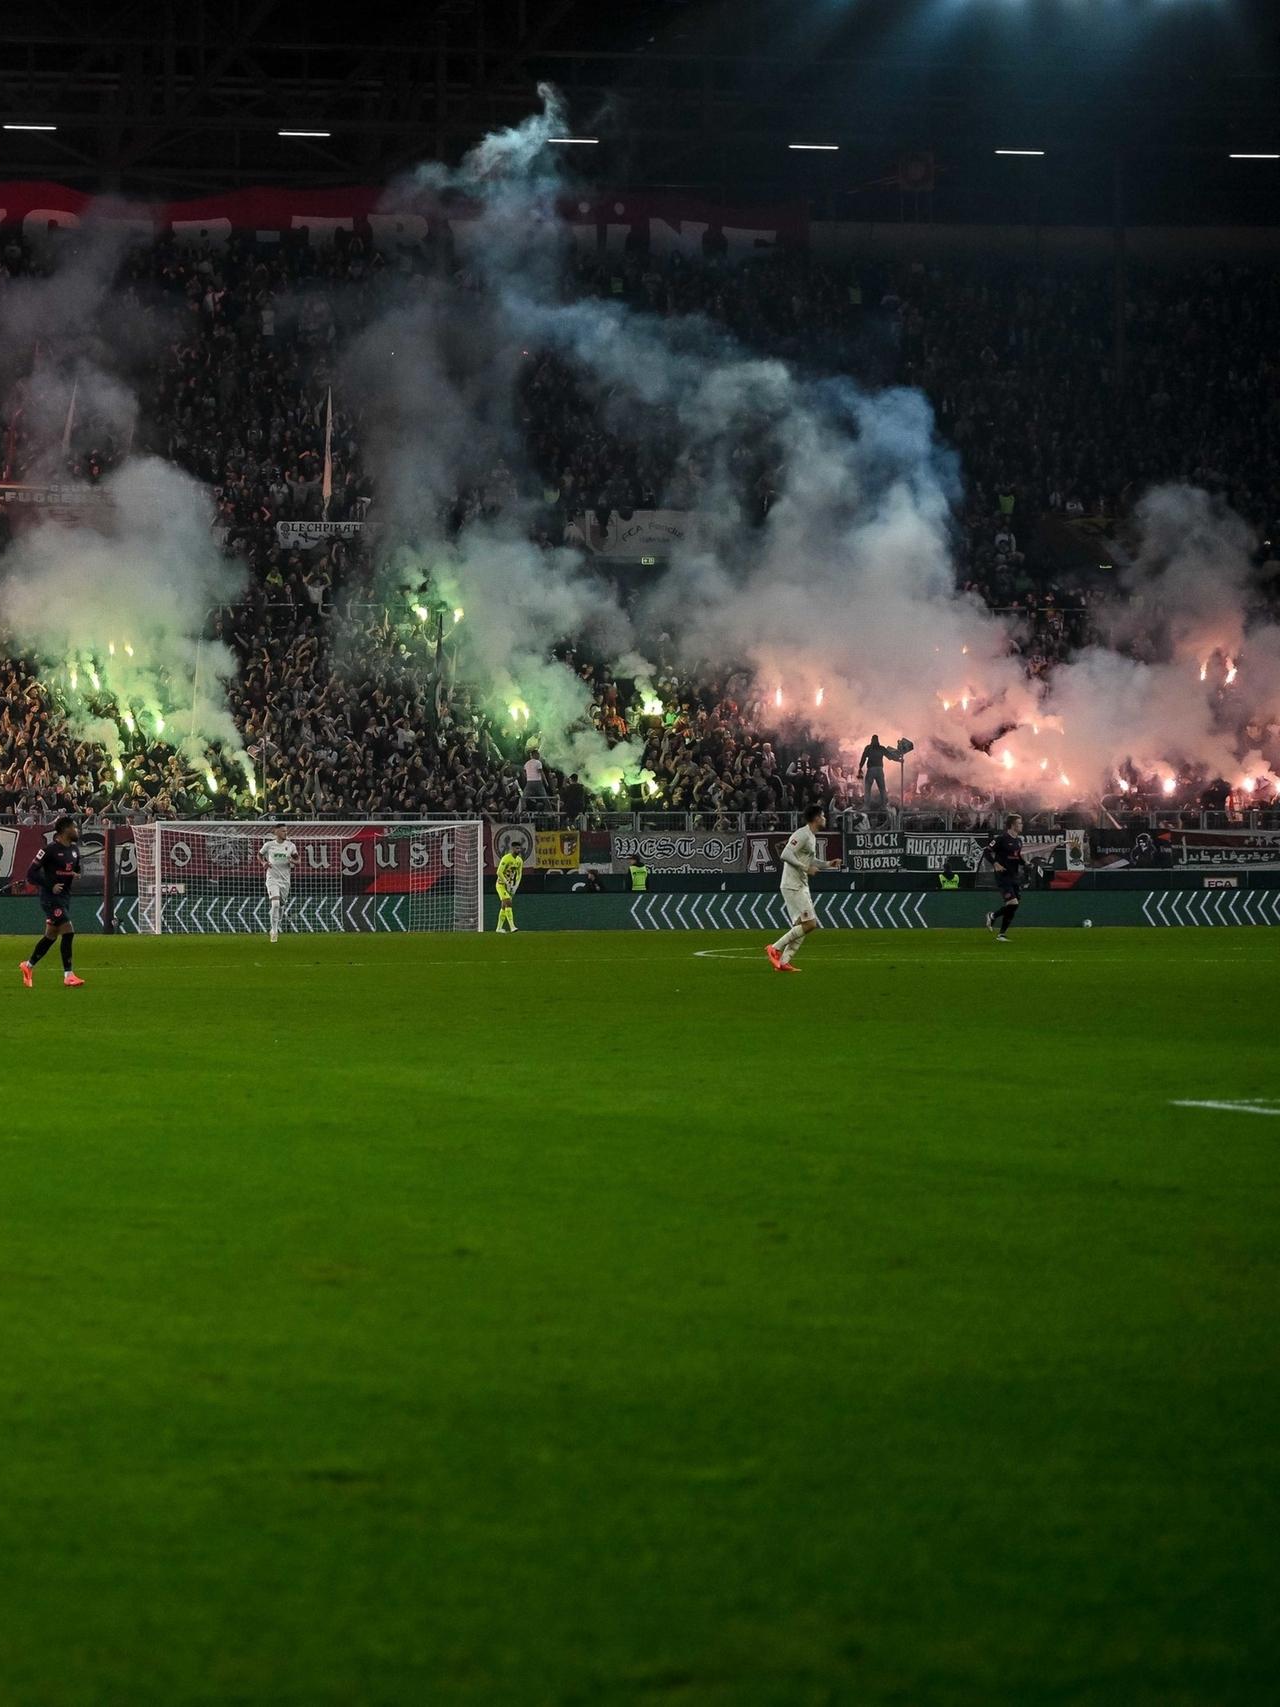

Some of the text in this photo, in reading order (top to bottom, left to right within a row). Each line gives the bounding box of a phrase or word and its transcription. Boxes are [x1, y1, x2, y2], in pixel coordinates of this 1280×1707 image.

[856, 833, 898, 848] BLOCK
[906, 838, 968, 855] AUGSBURG
[853, 856, 902, 870] BRIGADE
[927, 856, 947, 869] OST
